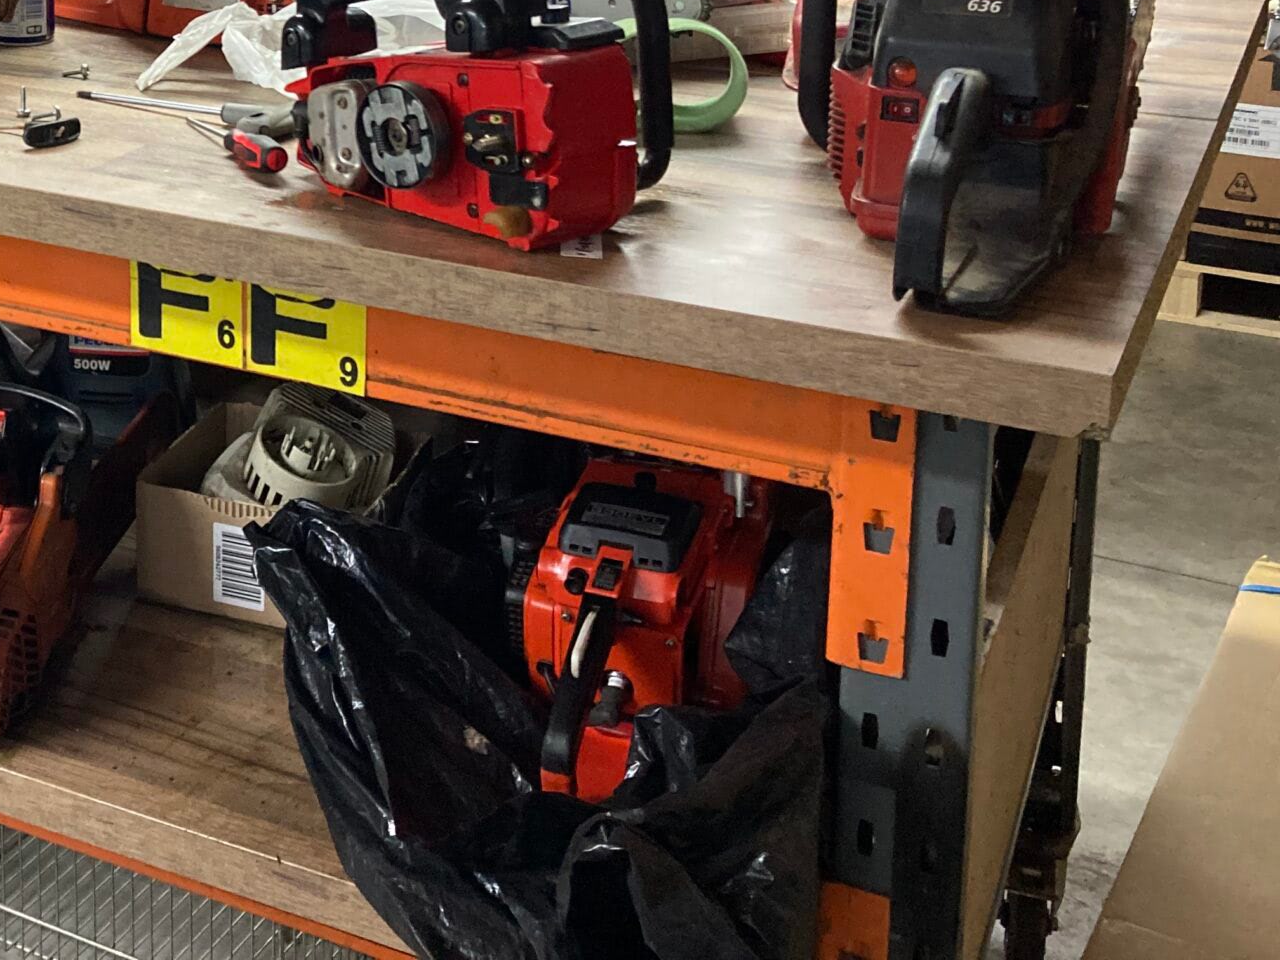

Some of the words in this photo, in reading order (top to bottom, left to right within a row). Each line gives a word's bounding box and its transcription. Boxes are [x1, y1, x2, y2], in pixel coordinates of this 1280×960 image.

[217, 319, 236, 349] 6
[73, 358, 111, 371] 500W
[339, 356, 359, 387] 9
